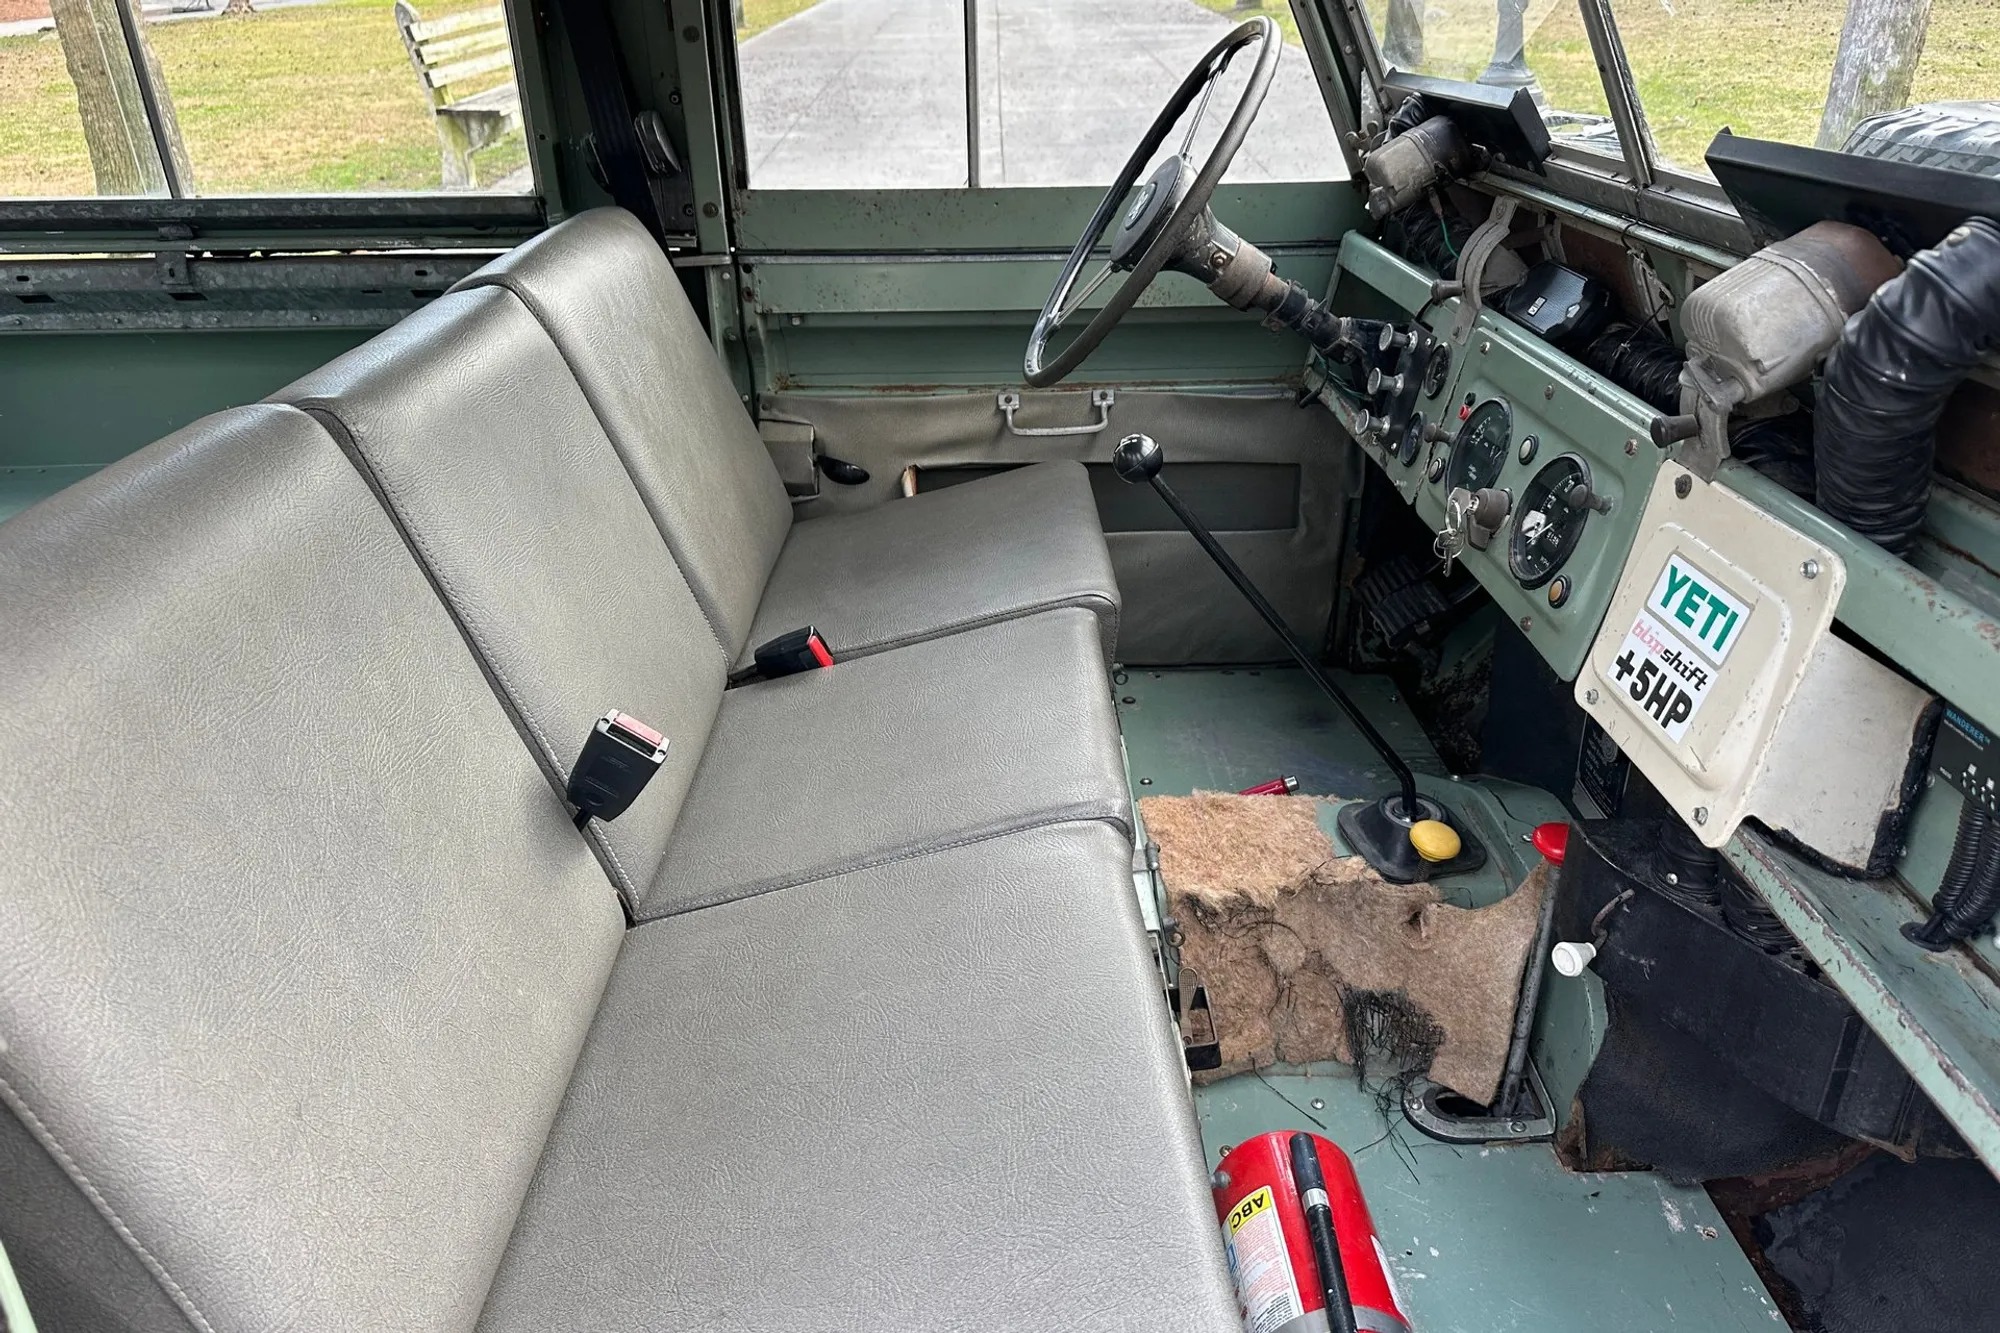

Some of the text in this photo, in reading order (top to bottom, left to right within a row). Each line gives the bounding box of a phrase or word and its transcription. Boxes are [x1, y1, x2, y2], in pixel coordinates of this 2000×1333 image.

[1661, 565, 1738, 652] YETI
[1615, 649, 1693, 729] +5HP
[1232, 1193, 1265, 1229] ABC
